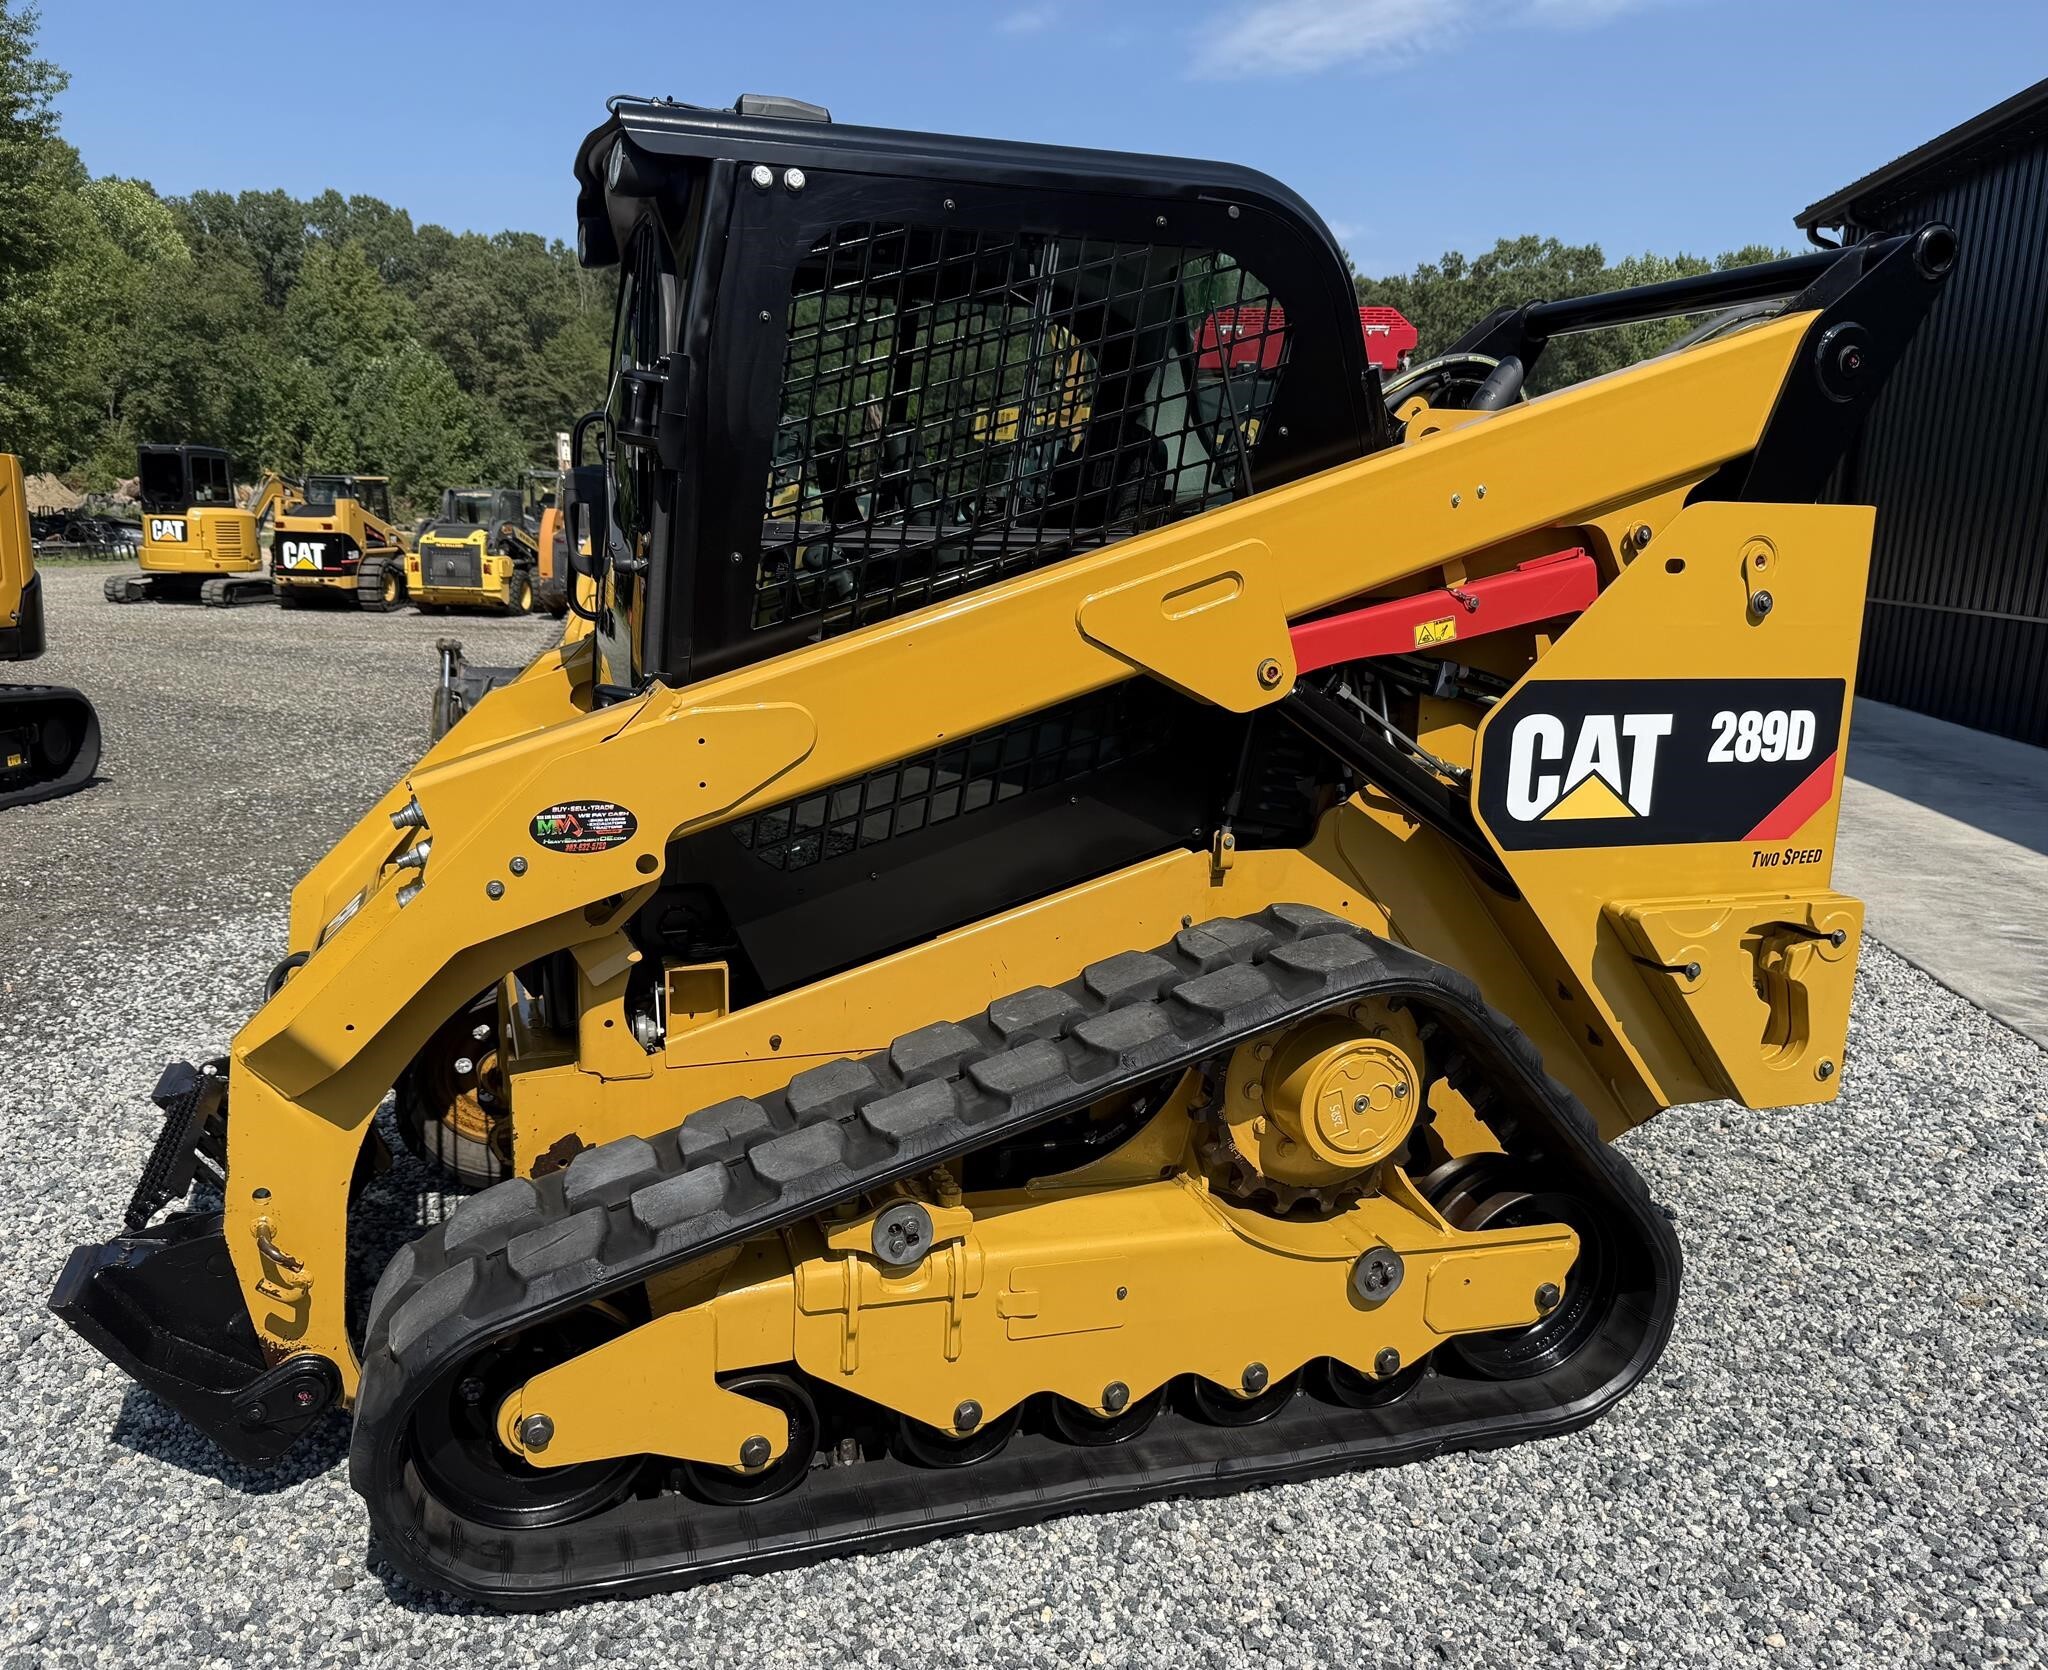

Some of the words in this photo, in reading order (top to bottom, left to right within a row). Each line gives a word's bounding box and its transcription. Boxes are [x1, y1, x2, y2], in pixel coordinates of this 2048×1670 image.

[151, 519, 185, 541] CAT
[282, 541, 327, 570] CAT
[1707, 709, 1816, 763] 289D
[1506, 713, 1674, 822] CAT
